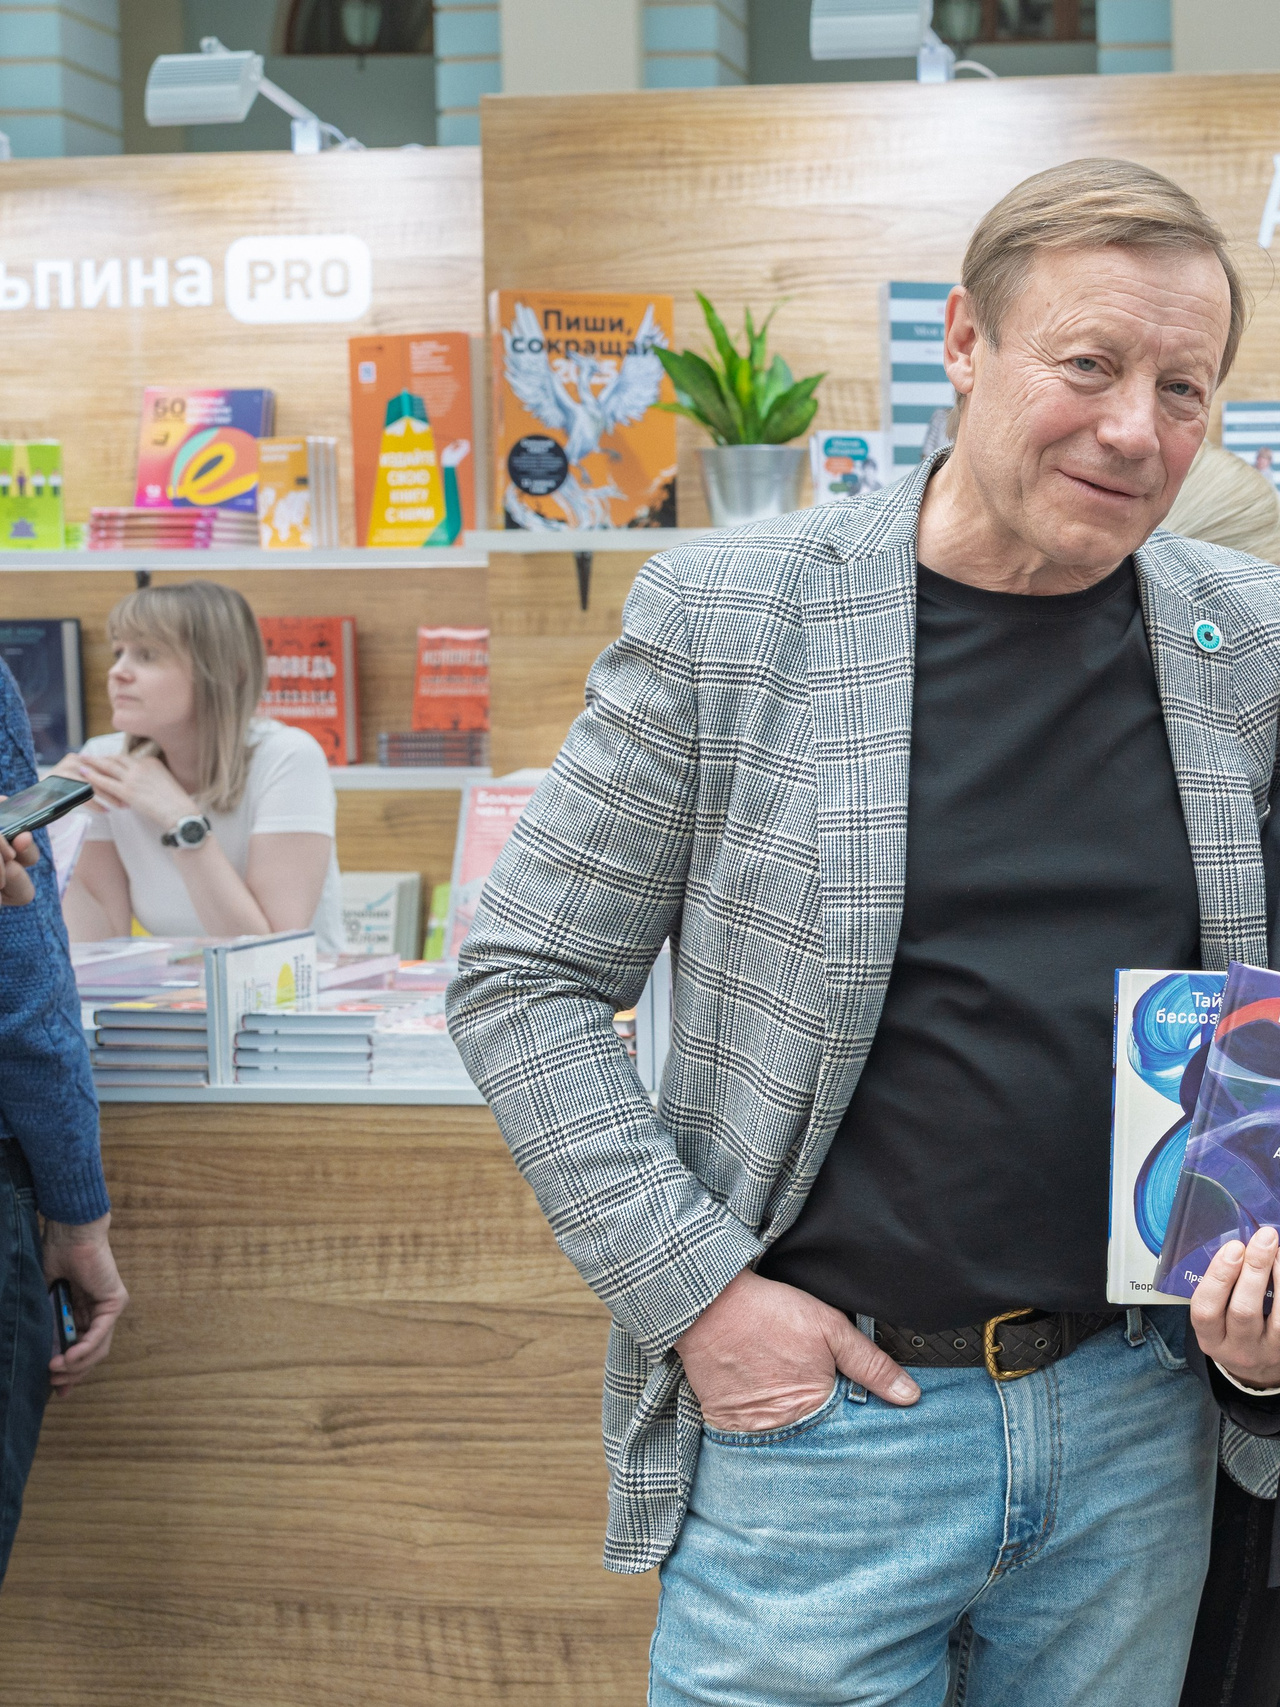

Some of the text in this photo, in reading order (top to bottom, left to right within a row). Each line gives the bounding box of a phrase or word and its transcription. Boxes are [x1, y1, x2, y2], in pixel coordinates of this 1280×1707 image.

[247, 258, 351, 300] PRO
[543, 309, 633, 335] Пиши,
[1191, 991, 1223, 1008] Тай
[1155, 1007, 1219, 1025] бессоз
